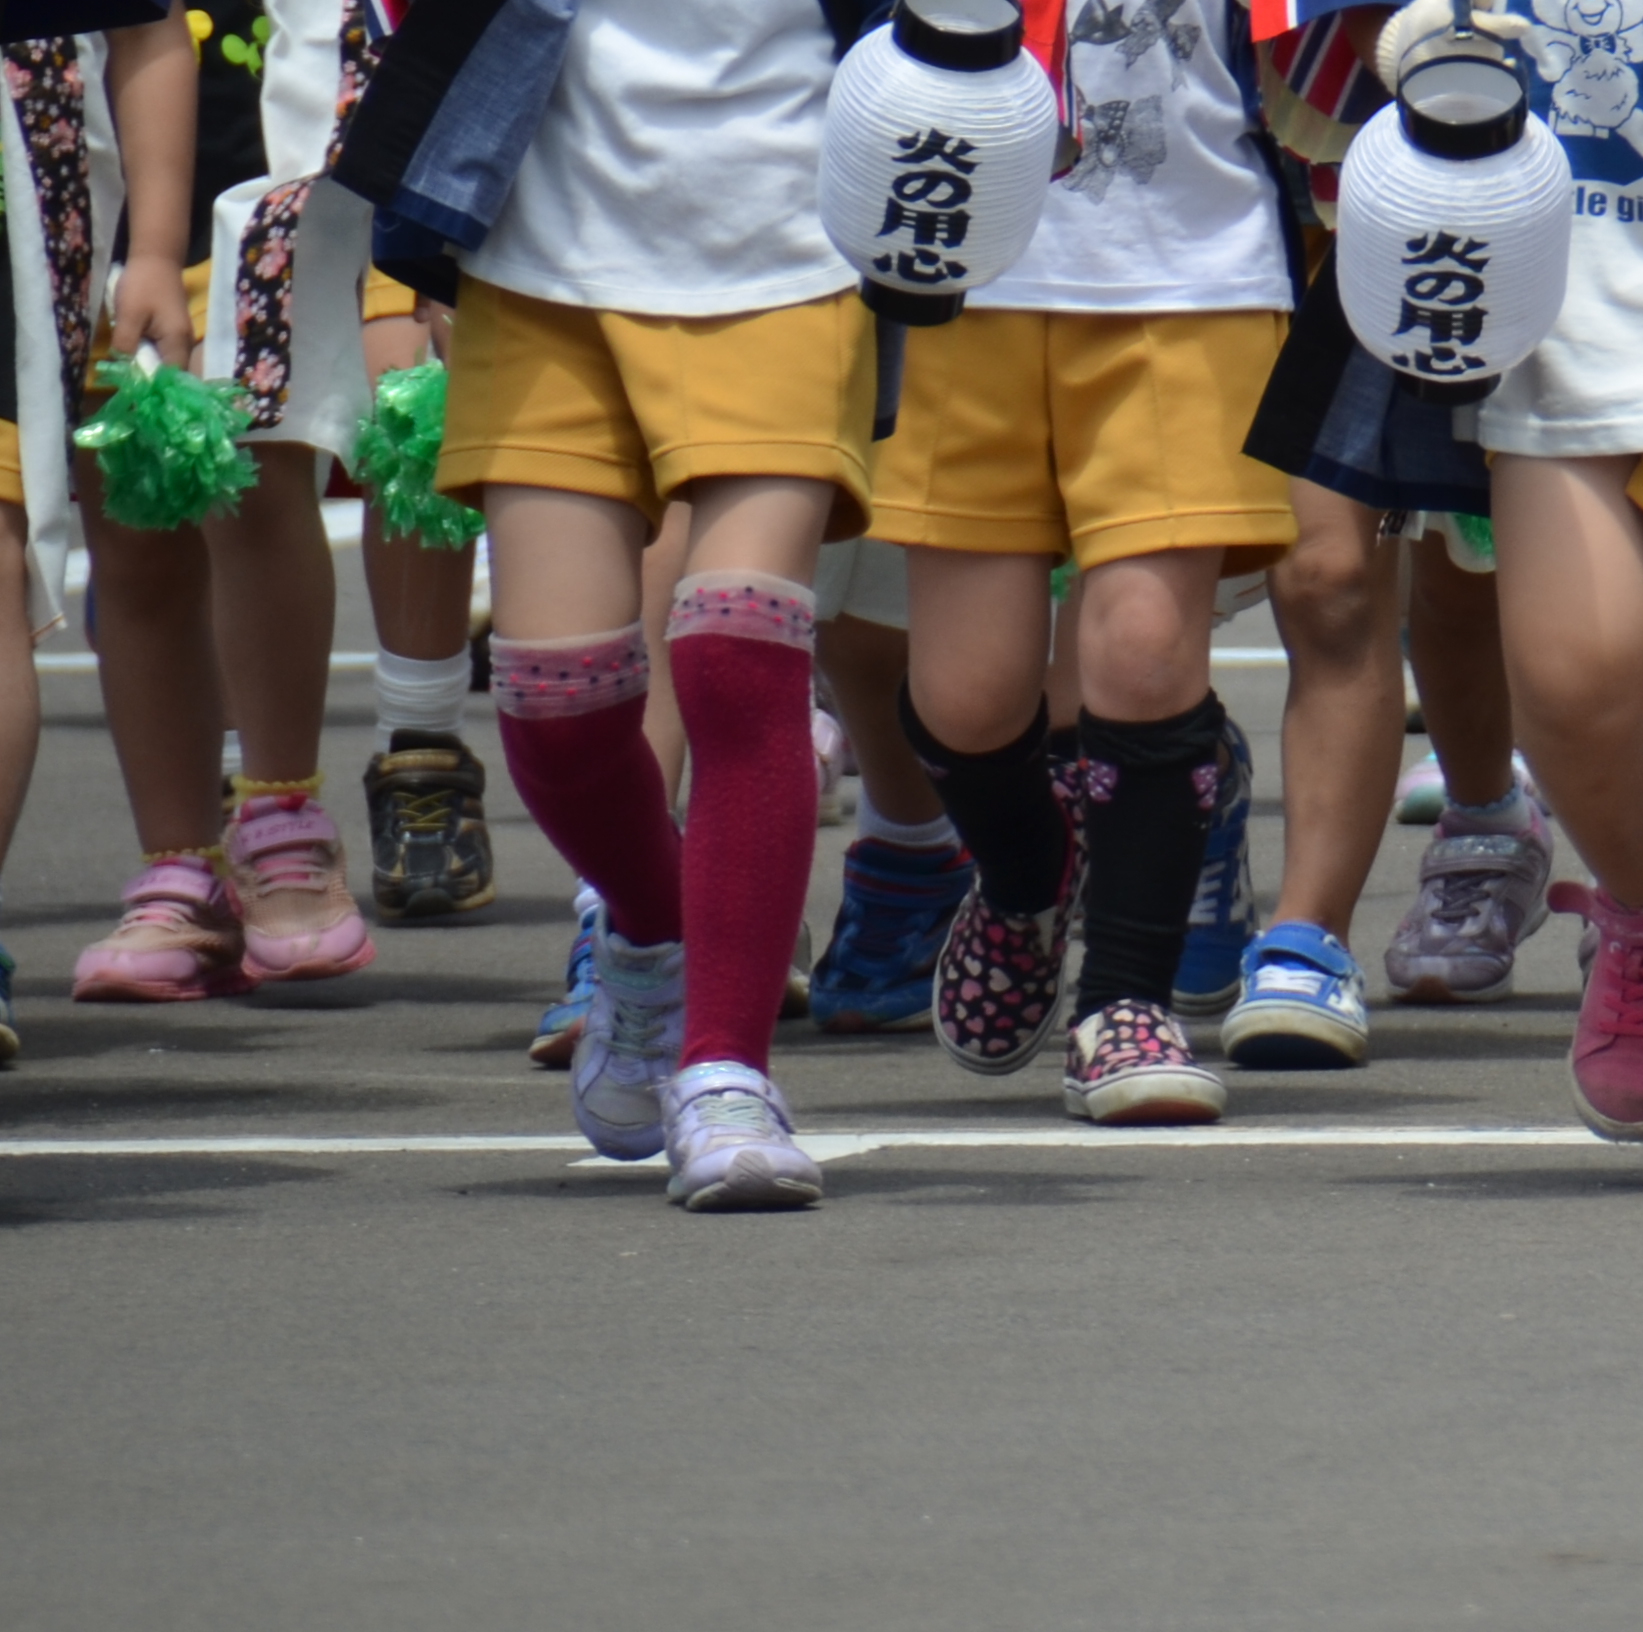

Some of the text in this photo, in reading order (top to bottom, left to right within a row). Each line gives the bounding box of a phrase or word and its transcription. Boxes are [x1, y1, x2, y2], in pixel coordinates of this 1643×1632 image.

[872, 127, 983, 284] 火の用心
[1391, 229, 1491, 376] 火の用心
